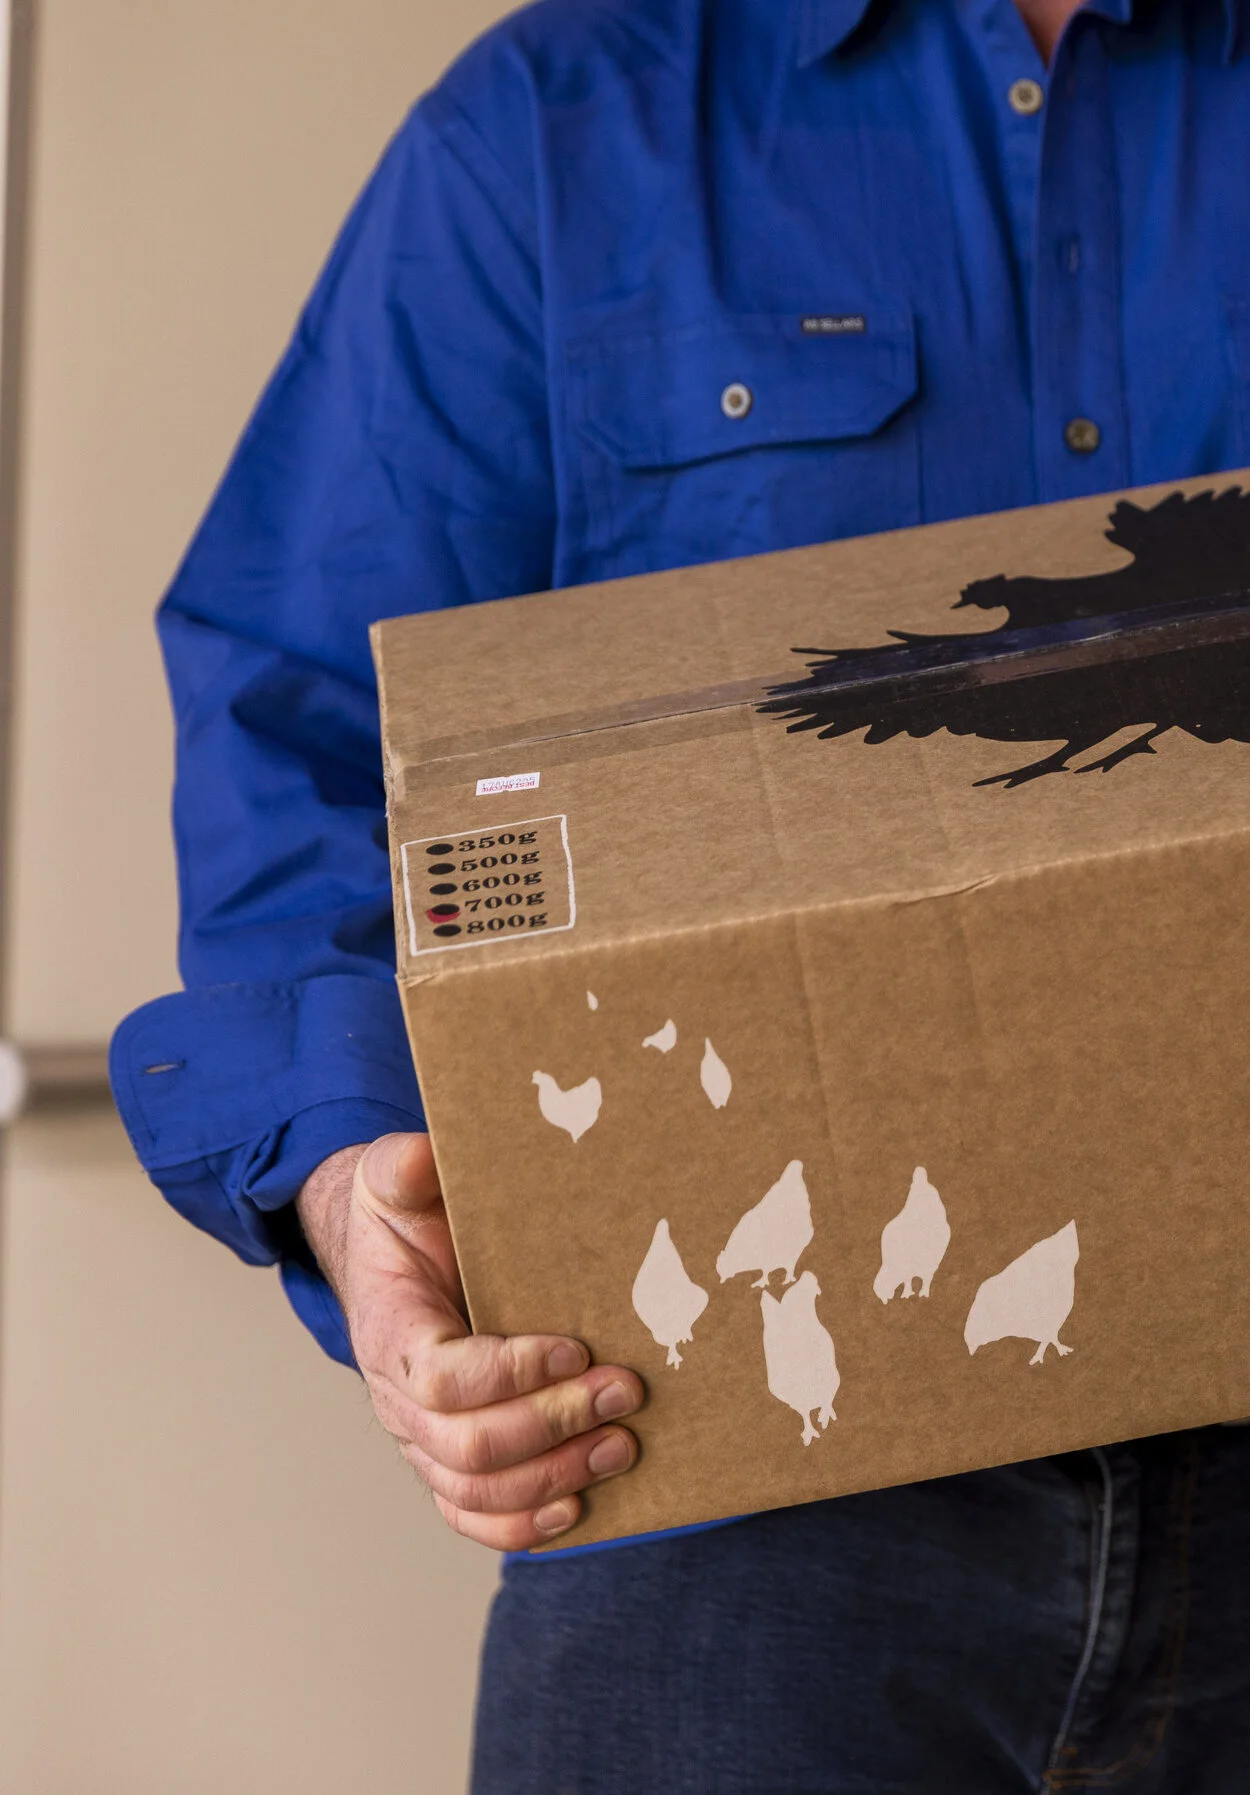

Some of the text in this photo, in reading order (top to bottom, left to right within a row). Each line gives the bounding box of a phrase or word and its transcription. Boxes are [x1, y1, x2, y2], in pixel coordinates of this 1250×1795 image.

[458, 831, 538, 852] 350g
[460, 851, 540, 872] 500g
[462, 871, 543, 892] 600g
[465, 891, 545, 912] 700g
[466, 912, 548, 935] 800g
